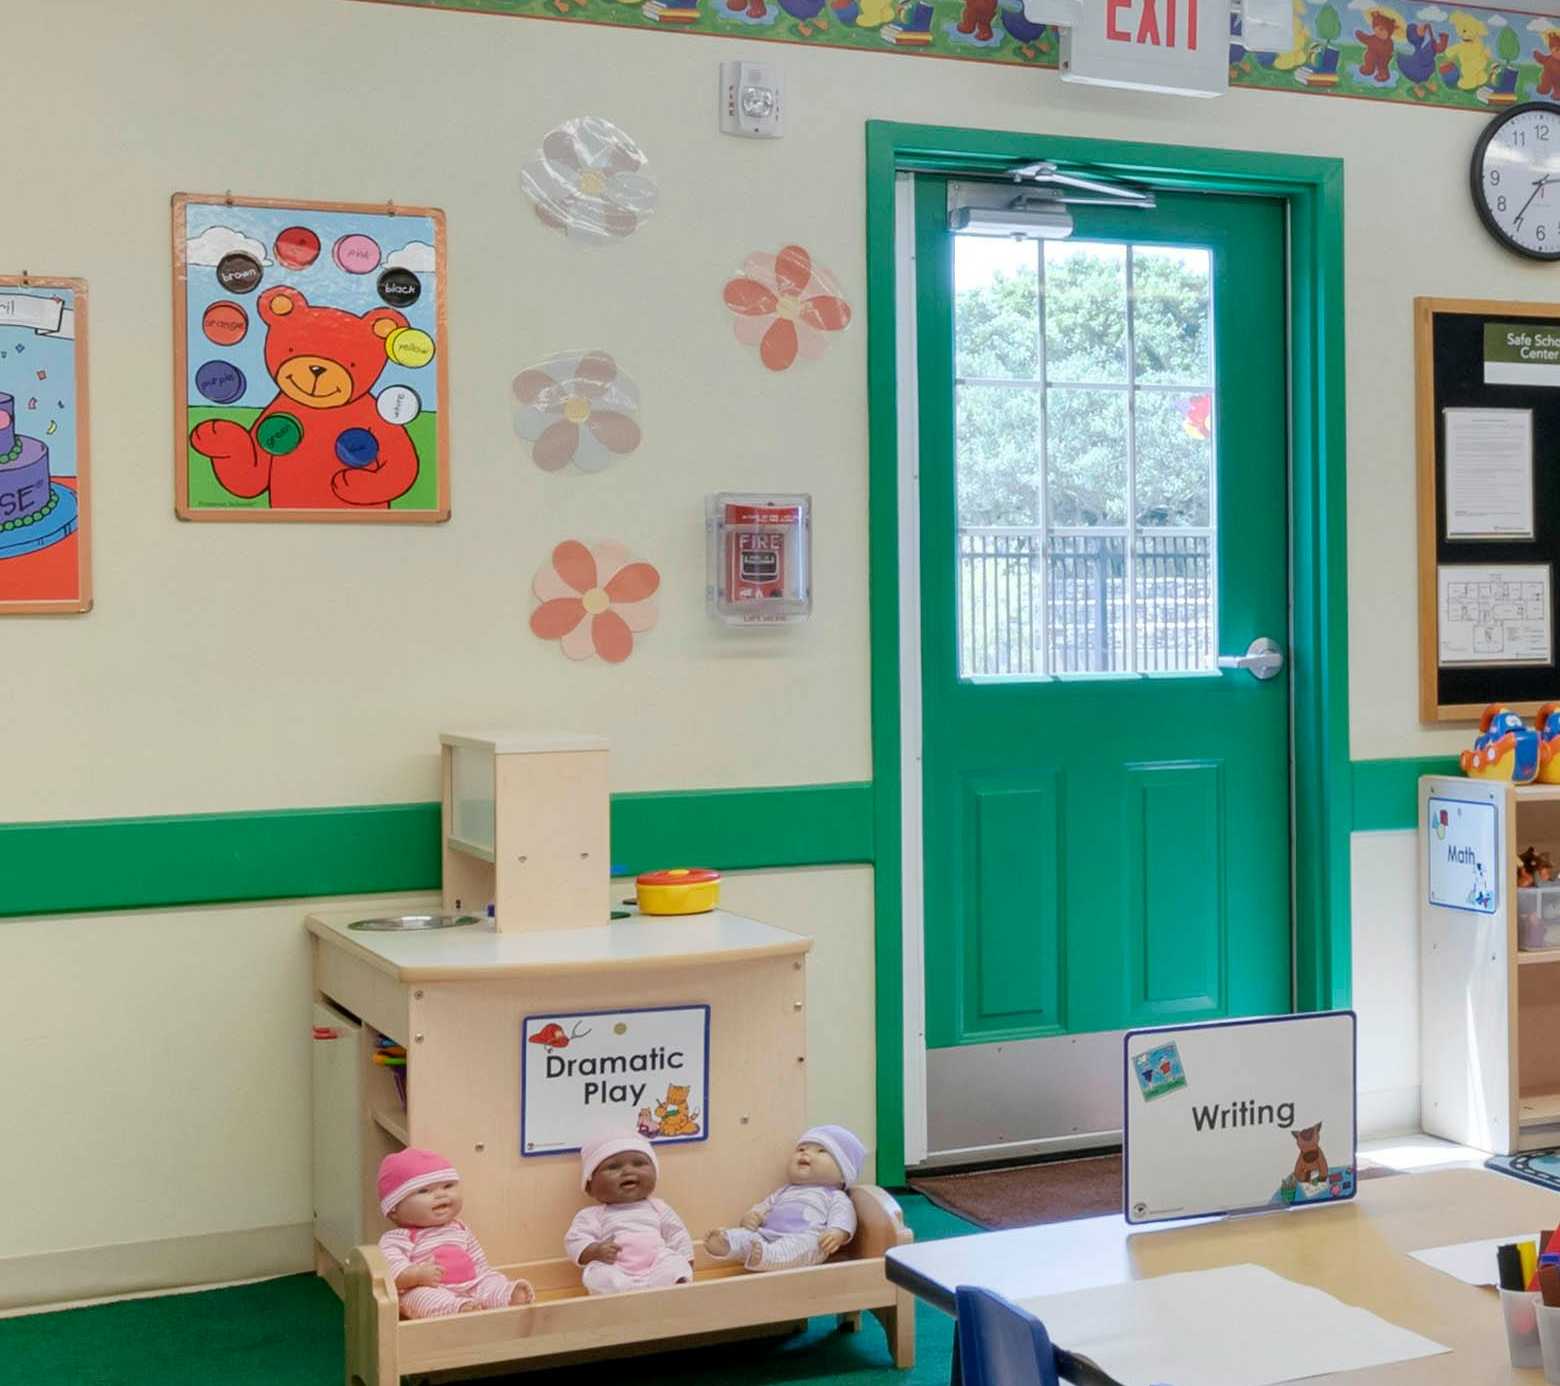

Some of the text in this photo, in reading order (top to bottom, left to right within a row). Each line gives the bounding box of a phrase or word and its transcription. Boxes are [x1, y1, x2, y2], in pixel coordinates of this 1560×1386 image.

[1513, 131, 1526, 146] 11
[1535, 124, 1549, 141] 12
[1490, 170, 1500, 186] 9
[1497, 196, 1507, 212] 8
[1515, 217, 1524, 233] 7
[1536, 225, 1546, 241] 6
[348, 249, 370, 260] pink
[221, 268, 257, 283] brown
[385, 283, 416, 295] black
[205, 318, 241, 331] orange
[1506, 333, 1531, 346] Safe
[398, 343, 429, 356] yellow
[1520, 347, 1560, 361] Center
[201, 373, 235, 389] purple
[266, 425, 290, 447] green
[740, 534, 780, 550] FIRE
[1447, 844, 1475, 865] Math
[546, 1047, 684, 1079] Dramatic
[584, 1081, 646, 1107] Play
[1192, 1100, 1296, 1132] Writing
